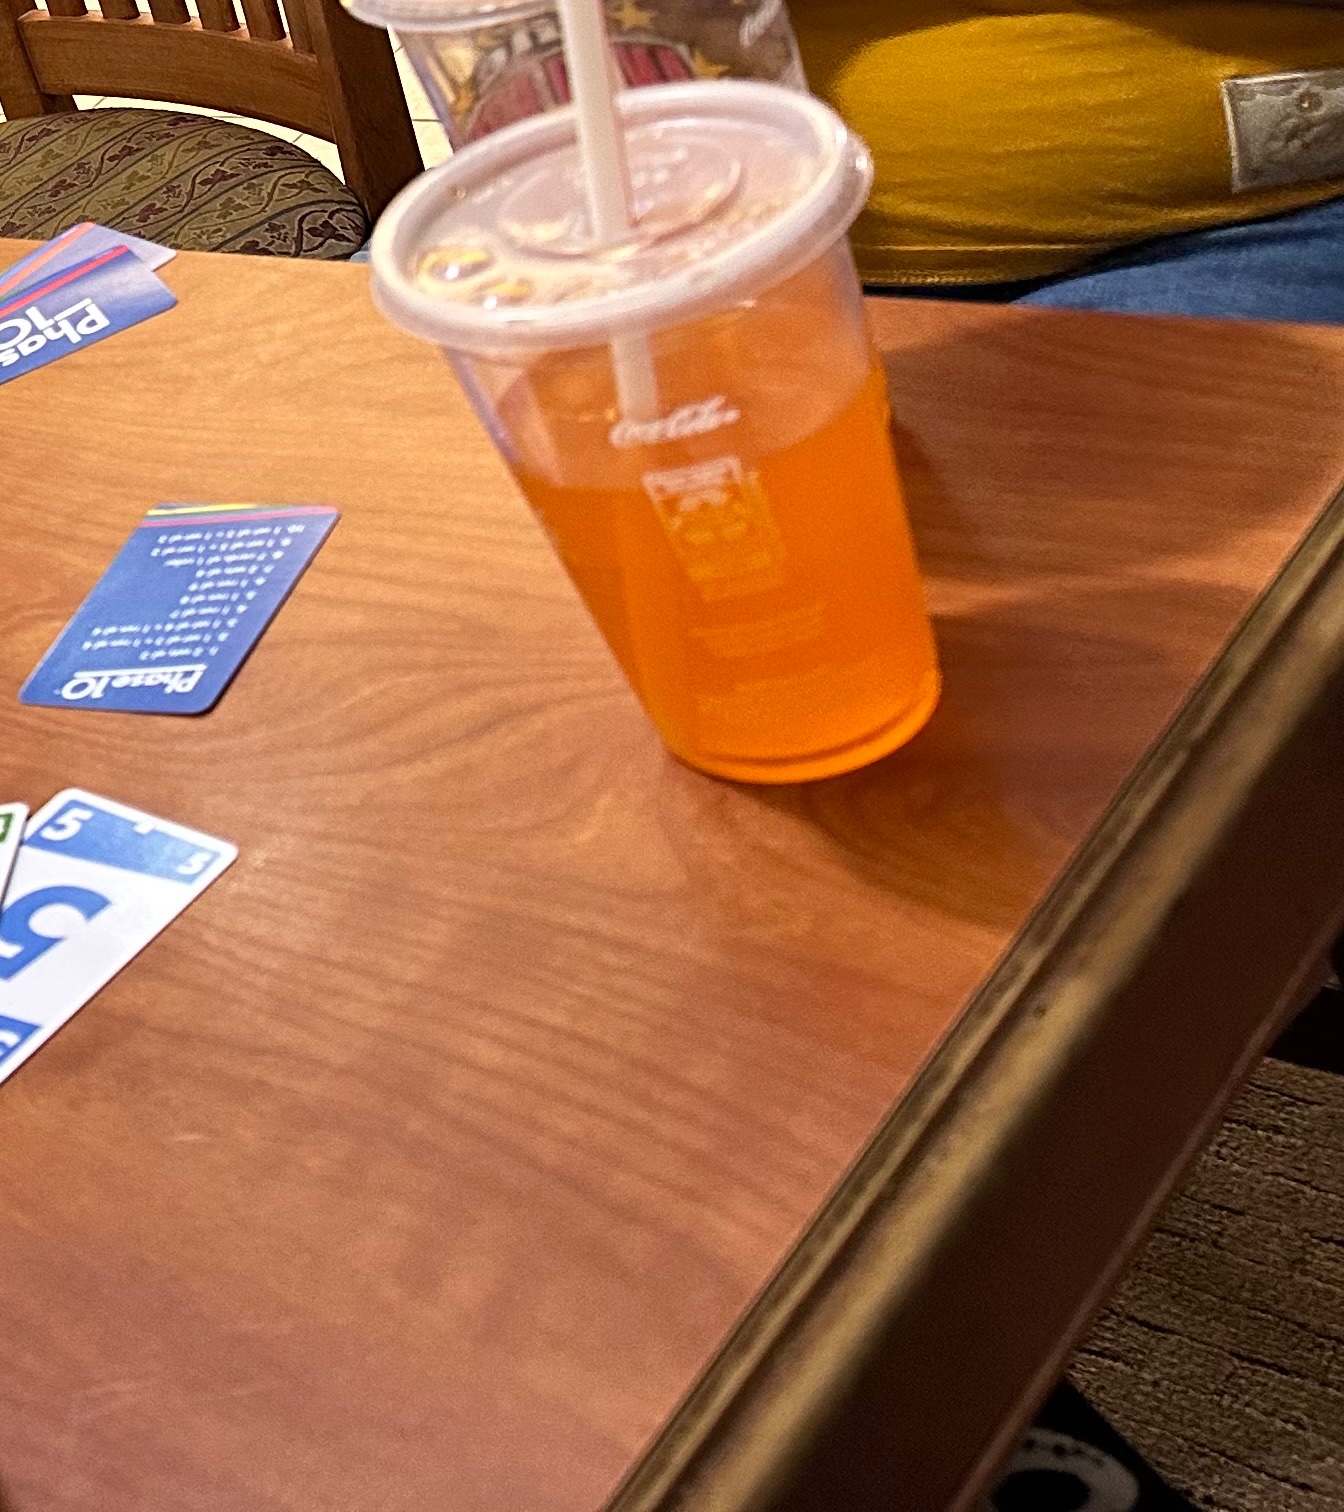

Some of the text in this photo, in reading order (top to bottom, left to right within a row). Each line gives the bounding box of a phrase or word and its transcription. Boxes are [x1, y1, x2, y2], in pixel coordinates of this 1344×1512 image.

[61, 675, 111, 701] 10
[112, 670, 205, 695] Phase
[40, 808, 93, 842] 5
[177, 851, 211, 876] 5
